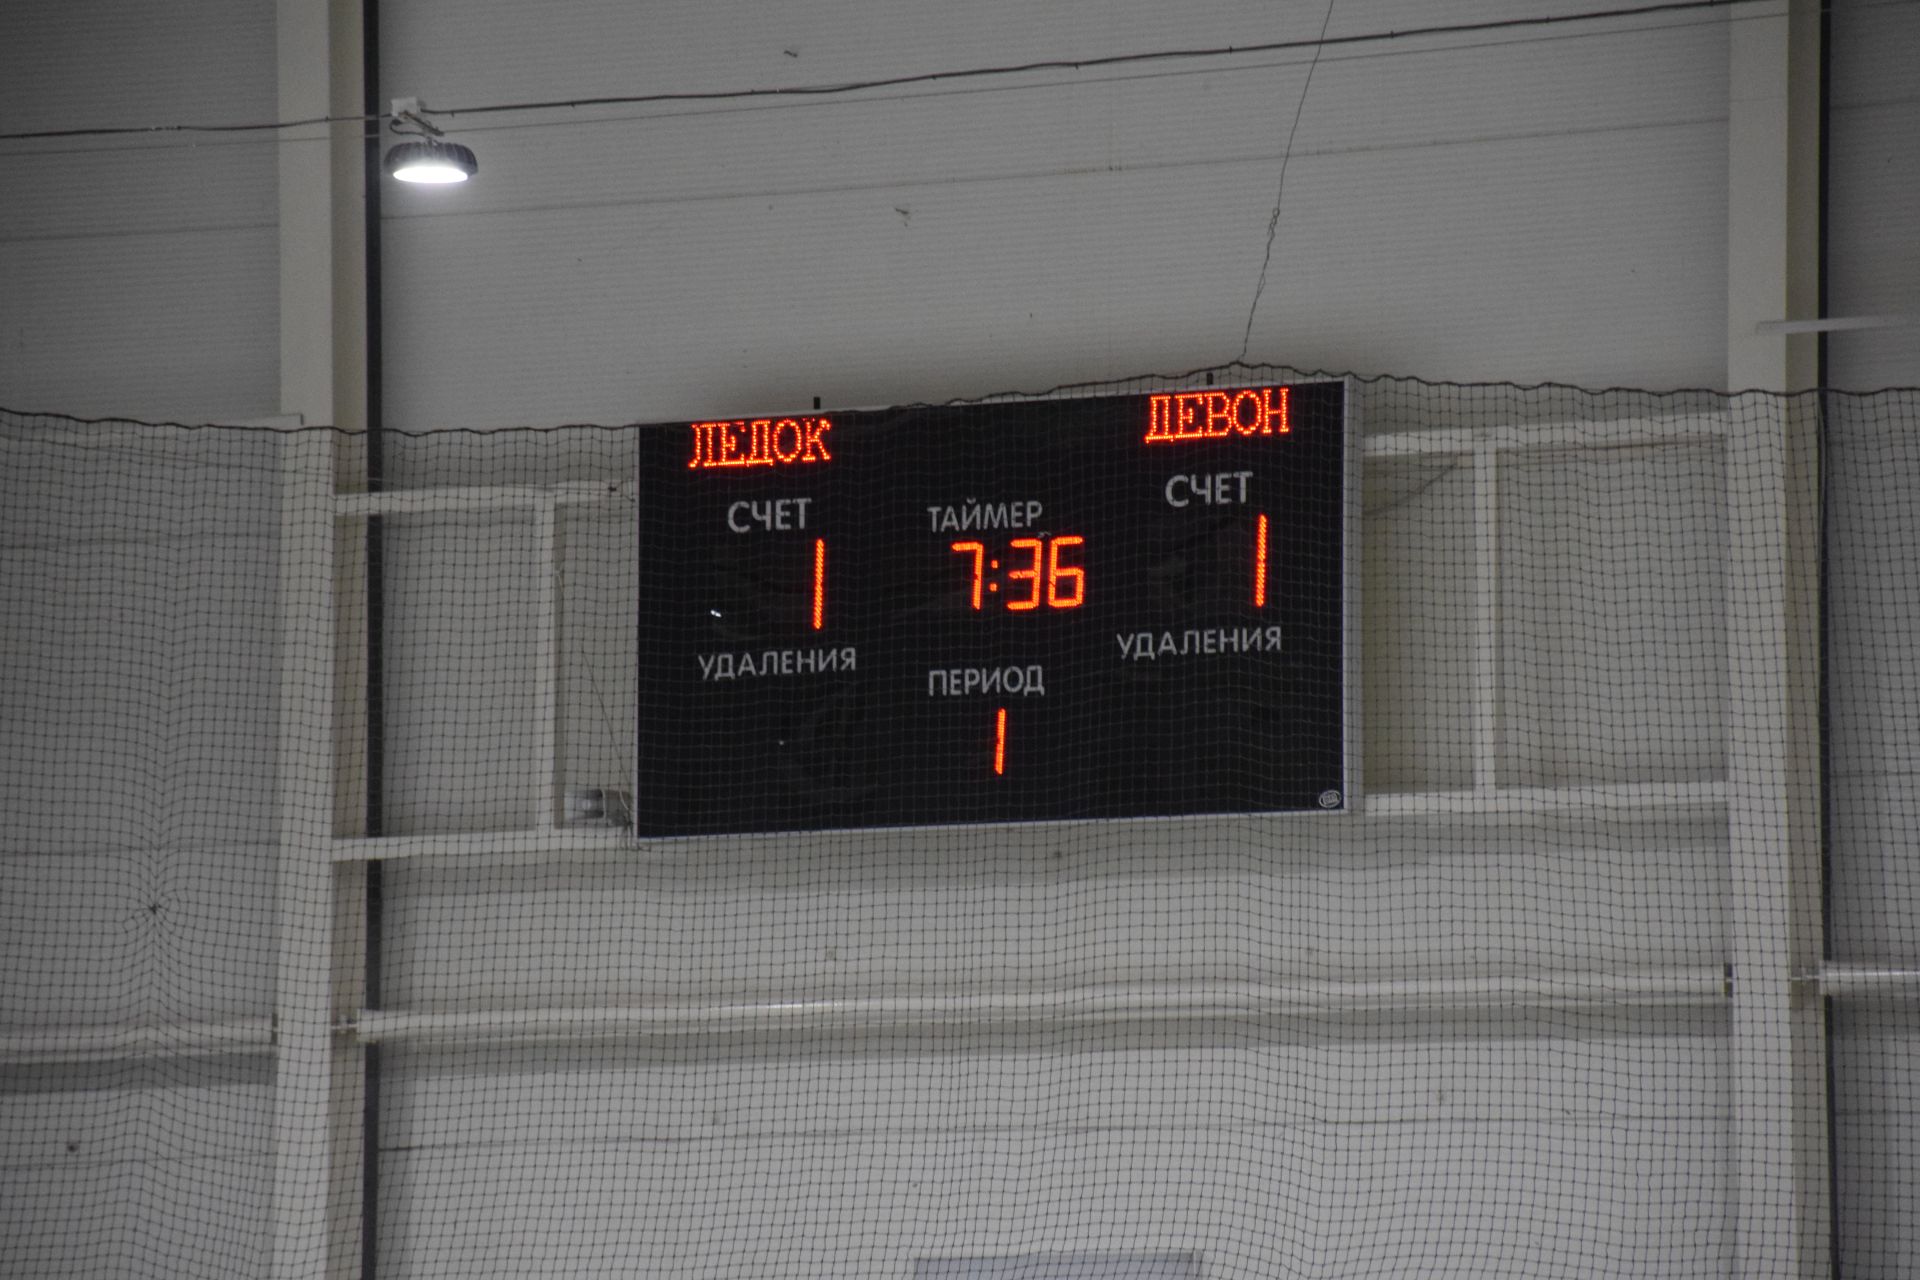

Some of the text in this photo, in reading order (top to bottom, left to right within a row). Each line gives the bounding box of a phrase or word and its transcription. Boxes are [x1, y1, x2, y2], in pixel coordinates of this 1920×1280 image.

[1144, 386, 1291, 445] ДЕВОН
[1164, 470, 1254, 508] СЧЕТ
[726, 497, 813, 534] СЧЕТ
[926, 498, 1044, 534] ТАЙМЕР
[950, 534, 1086, 612] 7:36
[1254, 512, 1269, 609] 1
[812, 537, 825, 631] 1
[1115, 624, 1284, 660] УДАЛЕНИЯ
[697, 646, 858, 682] УДАЛЕНИЯ
[927, 663, 1047, 698] ПЕРИОД
[993, 706, 1008, 777] 1
